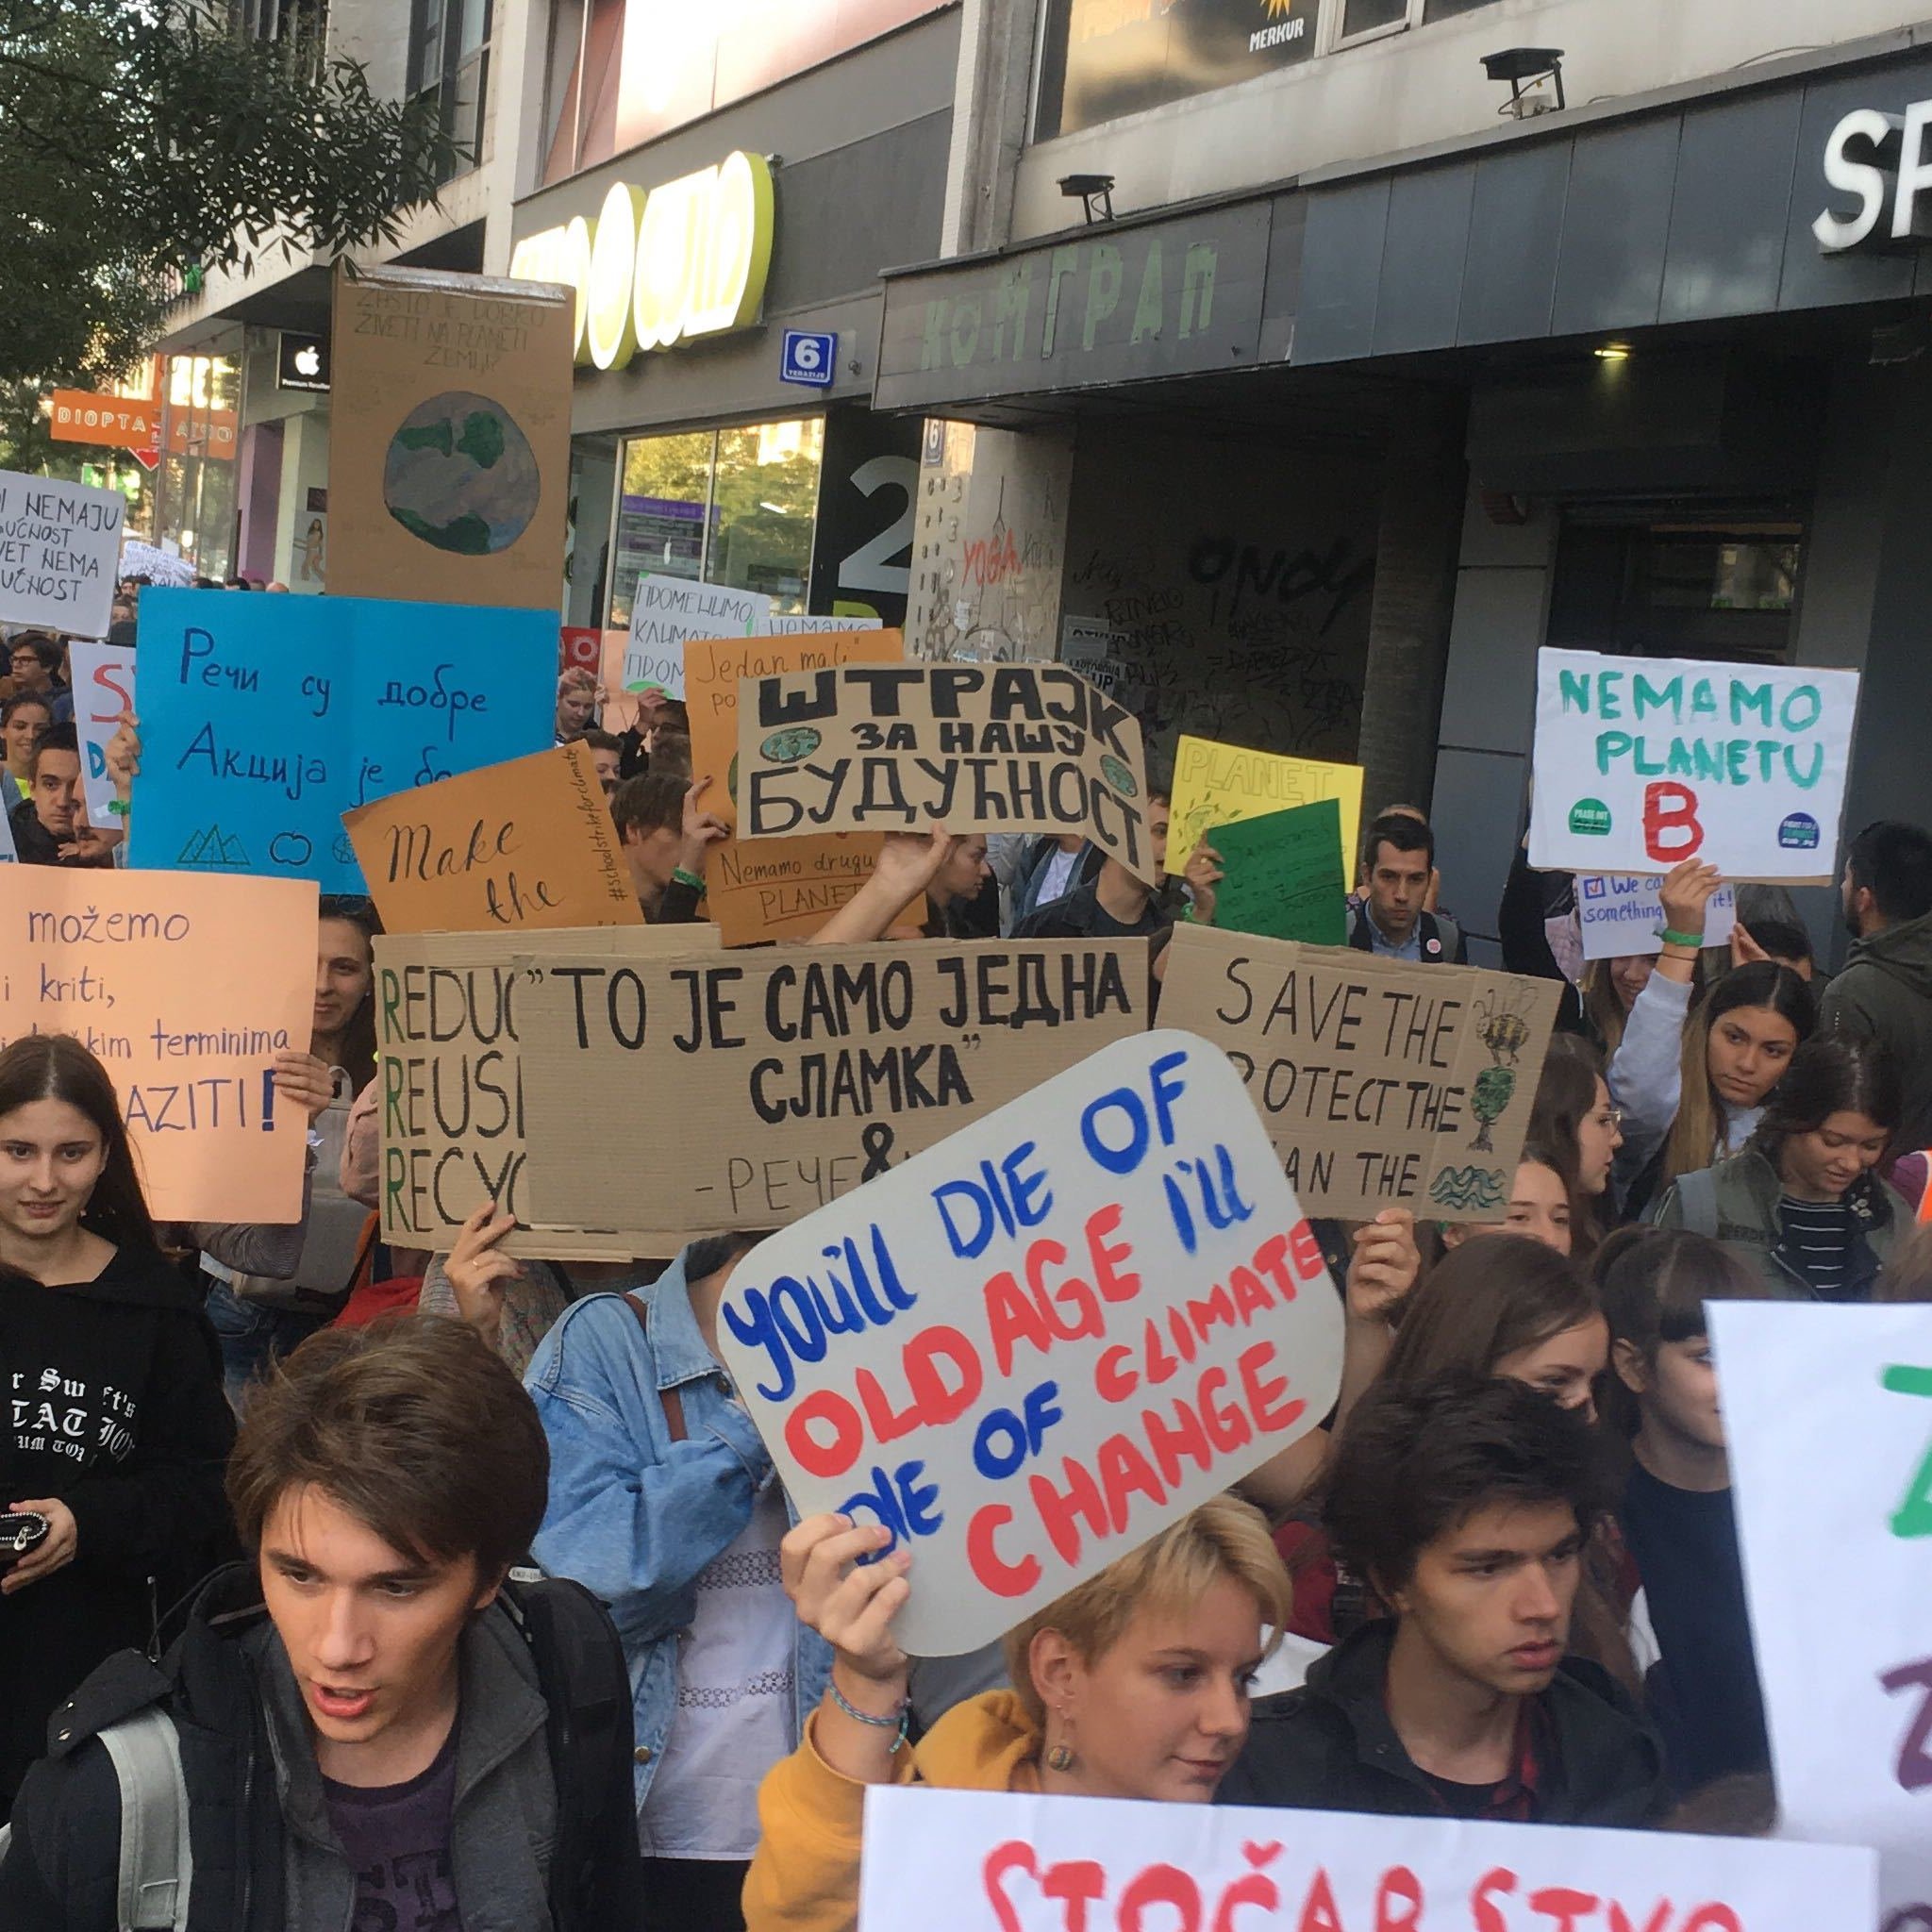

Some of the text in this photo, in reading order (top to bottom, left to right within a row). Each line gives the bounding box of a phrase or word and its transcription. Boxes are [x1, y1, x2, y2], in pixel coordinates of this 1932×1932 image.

[1249, 18, 1305, 53] MERKUR
[794, 339, 821, 370] 6
[58, 407, 147, 432] DIOPTA
[25, 491, 119, 531] NEMAJU
[838, 456, 920, 593] 2
[42, 548, 98, 578] NEMA
[180, 627, 488, 742] Речи су добре
[696, 645, 789, 683] Jedan
[758, 668, 1131, 763] ШТРАЈК
[1559, 669, 1823, 733] NEMAMO
[176, 722, 326, 800] Акција
[349, 757, 383, 808] је
[850, 722, 1086, 758] ЗА НАШУ
[1595, 730, 1824, 791] PLANETU
[1181, 742, 1334, 801] PLANET
[750, 757, 1143, 870] БУДУЋНОСТ
[1641, 780, 1705, 864] B
[384, 819, 522, 883] Make
[720, 849, 875, 886] Nemamo drugu
[486, 872, 566, 924] the
[759, 883, 865, 920] PLANET
[1584, 891, 1733, 924] something it!
[1610, 875, 1665, 894] We ca
[28, 906, 190, 943] možemo
[40, 962, 116, 1008] kriti,
[670, 966, 746, 1054] ЈЕ
[765, 959, 913, 1042] САМО
[936, 951, 1132, 1029] ЈЕДНА
[1216, 957, 1461, 1069] SAVE THE
[151, 1018, 291, 1061] terminima
[1407, 1081, 1465, 1133] THE
[931, 1140, 1055, 1259] DIE
[1080, 1051, 1189, 1174] OF
[1356, 1152, 1421, 1198] THE
[784, 1324, 983, 1478] OLD
[983, 1203, 1142, 1378] AGE
[836, 1219, 1325, 1566] DIE OF CLIMATE
[966, 1340, 1307, 1597] CHANGE
